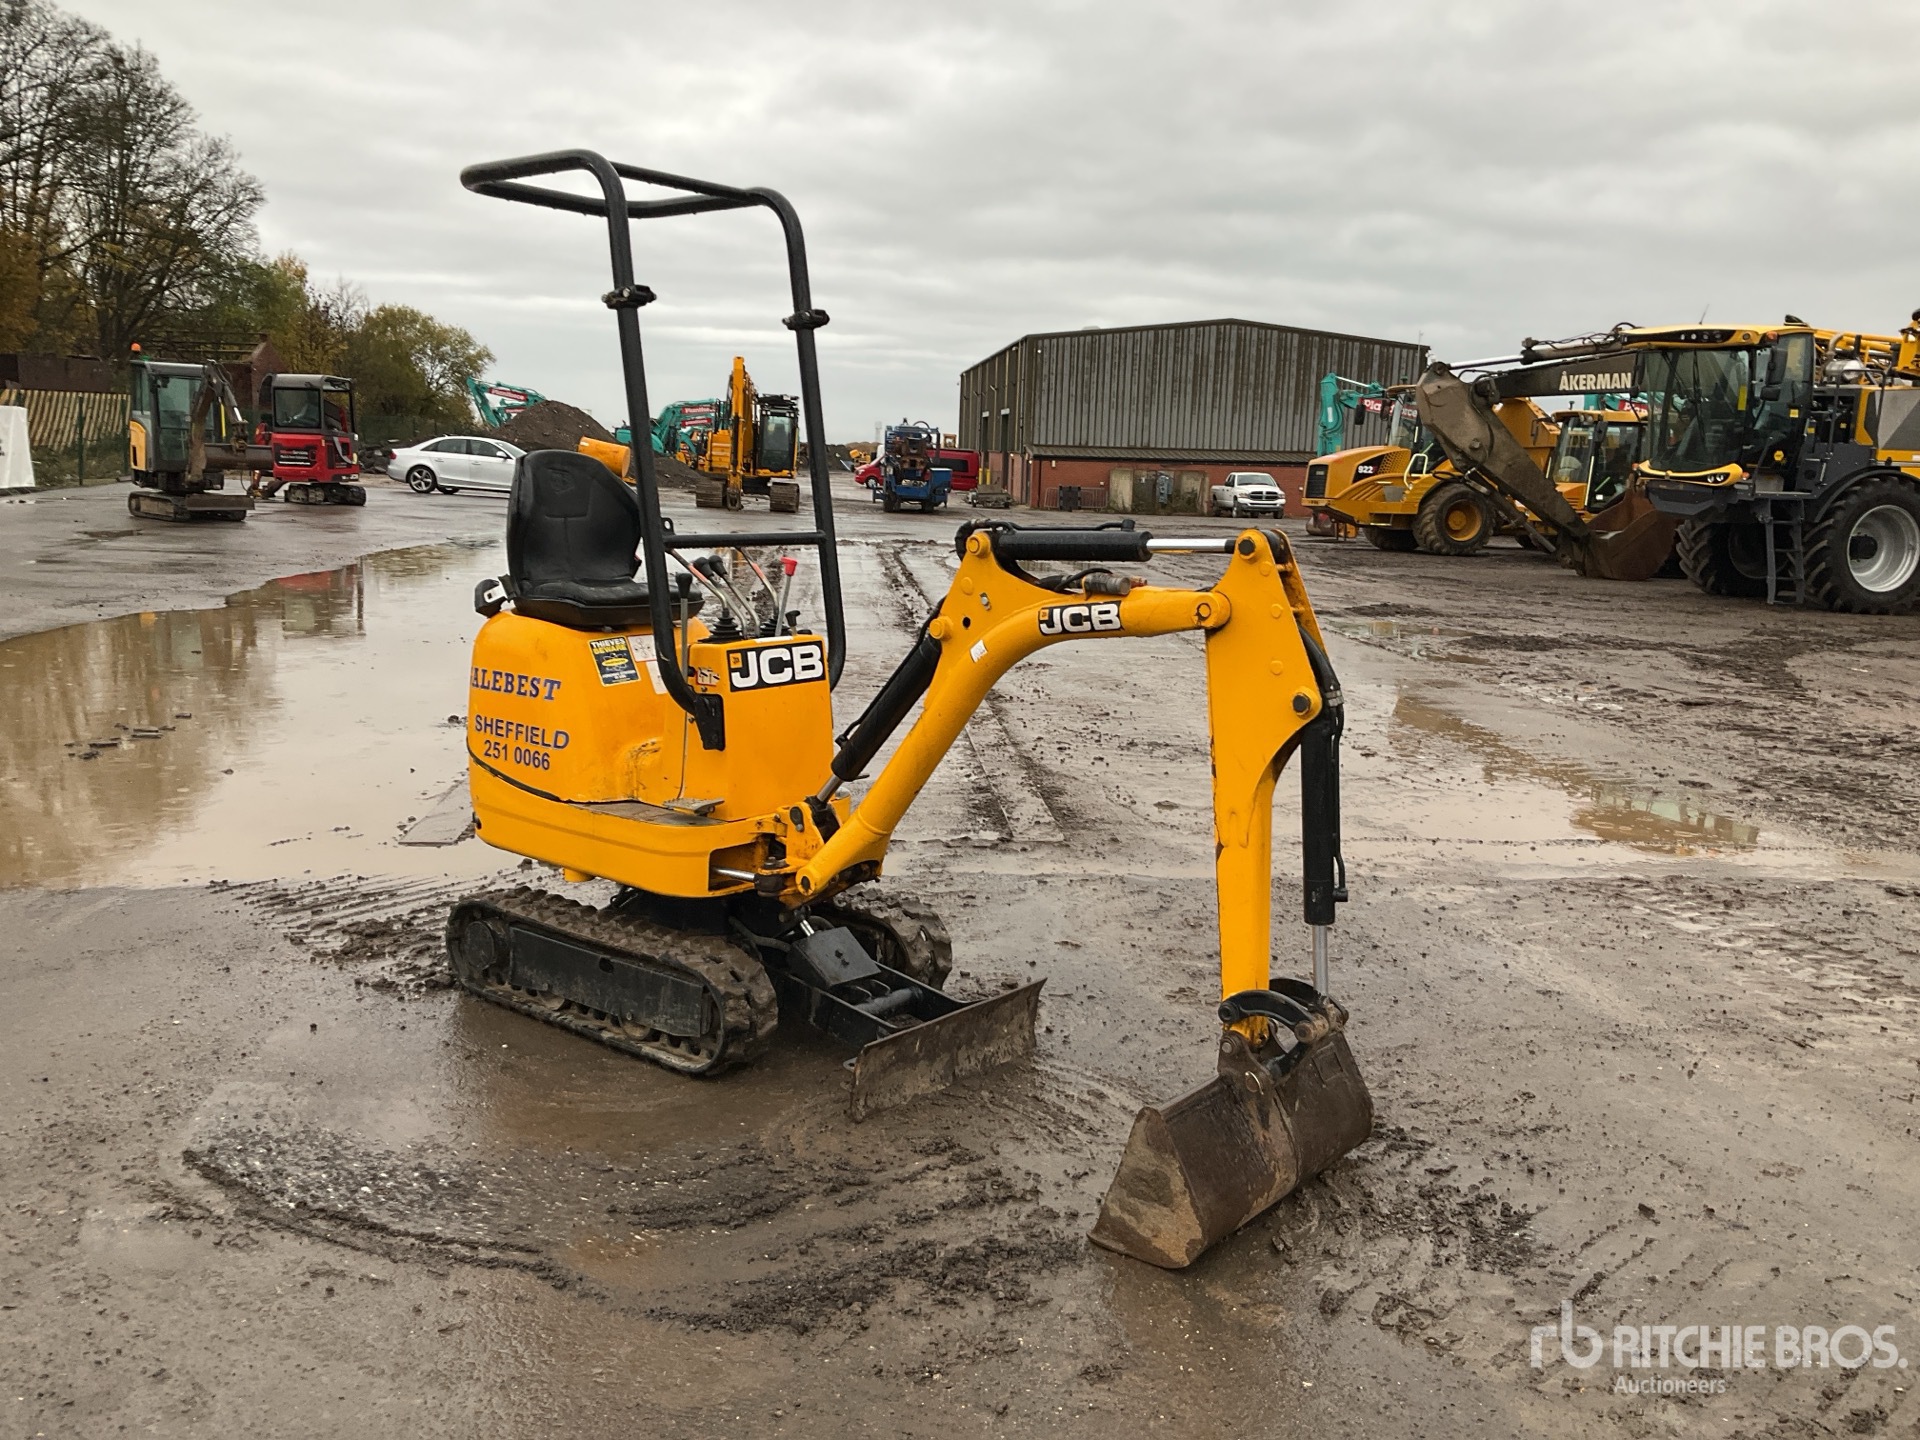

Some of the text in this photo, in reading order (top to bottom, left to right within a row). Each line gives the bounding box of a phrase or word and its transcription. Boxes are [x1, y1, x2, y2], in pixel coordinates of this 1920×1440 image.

[1559, 371, 1632, 390] ÅKERMAN
[1039, 603, 1121, 635] JCB
[590, 638, 626, 649] THIEVES
[731, 645, 824, 688] JCB
[470, 666, 562, 701] ALEBEST
[475, 714, 570, 749] SHEFFIELD
[484, 739, 551, 771] 251 0066
